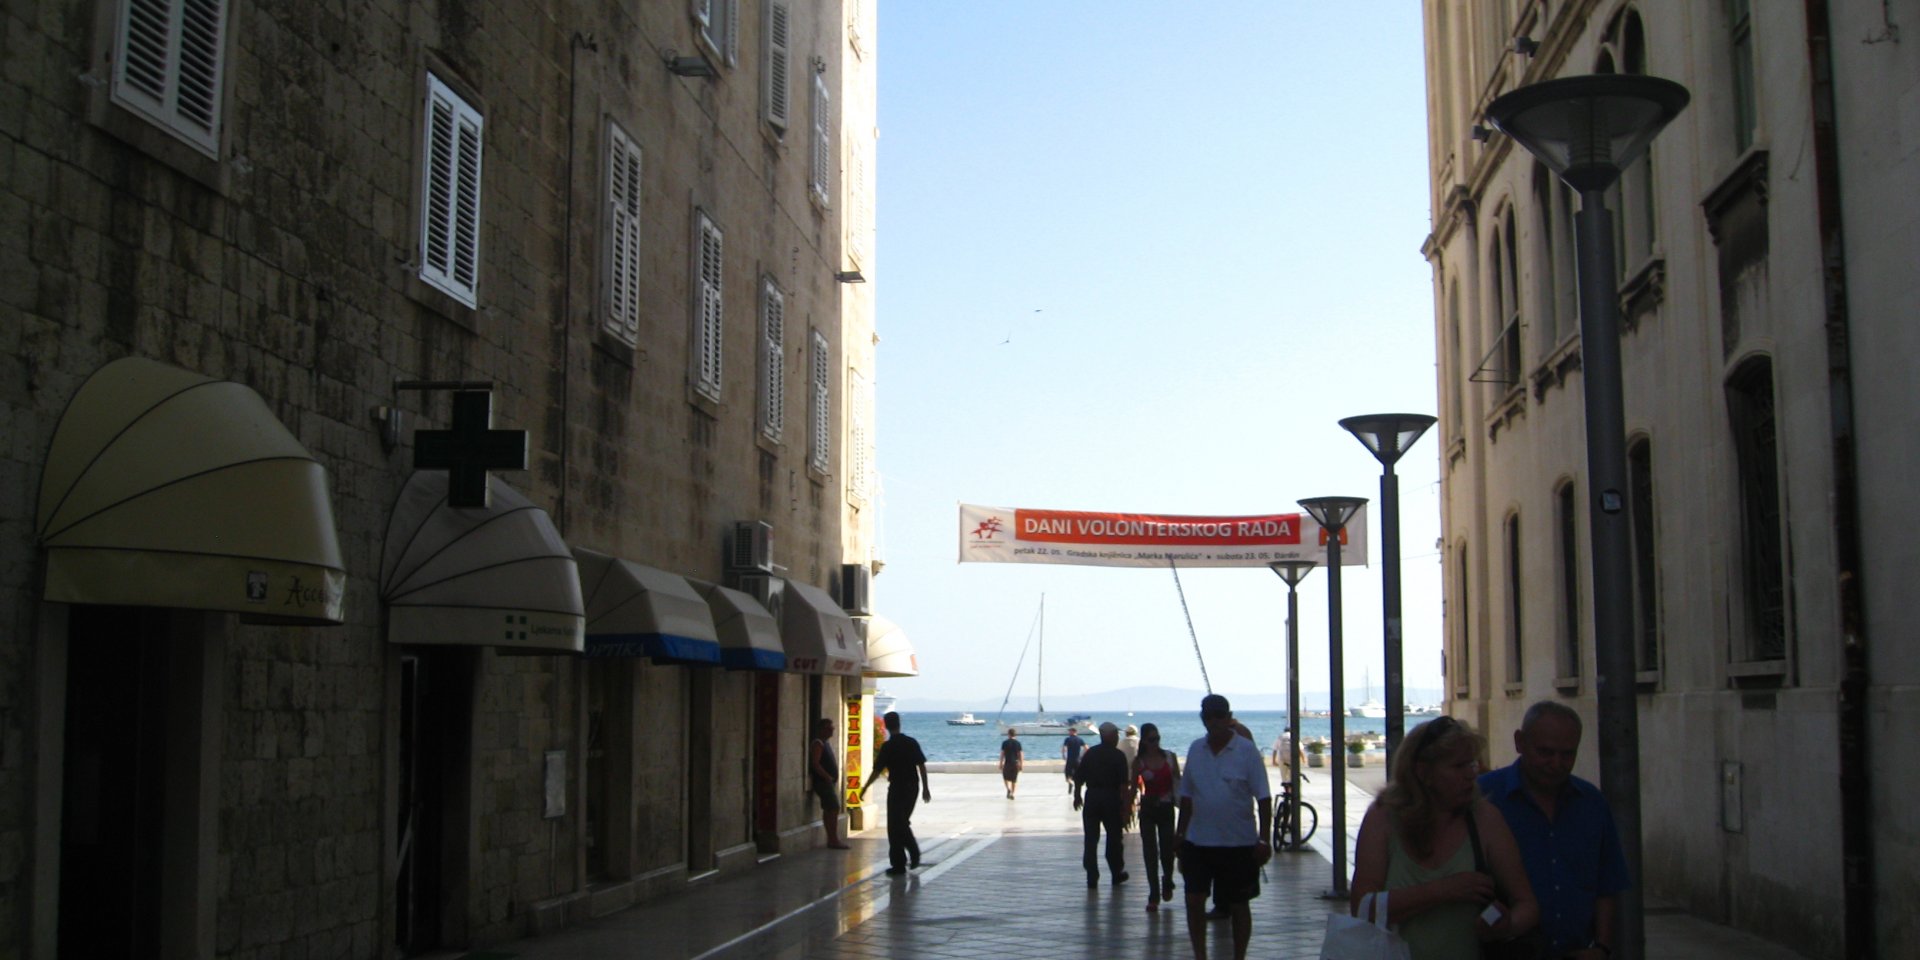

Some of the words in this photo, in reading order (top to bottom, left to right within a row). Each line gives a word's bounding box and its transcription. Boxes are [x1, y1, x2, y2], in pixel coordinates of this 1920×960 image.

[1024, 517, 1073, 535] DANI
[1076, 518, 1232, 538] VOLONTERSKOG
[1237, 520, 1291, 537] RADA
[1013, 547, 1035, 555] petak
[1216, 552, 1243, 560] subota
[793, 657, 818, 670] CUT
[847, 702, 862, 805] PIZZA
